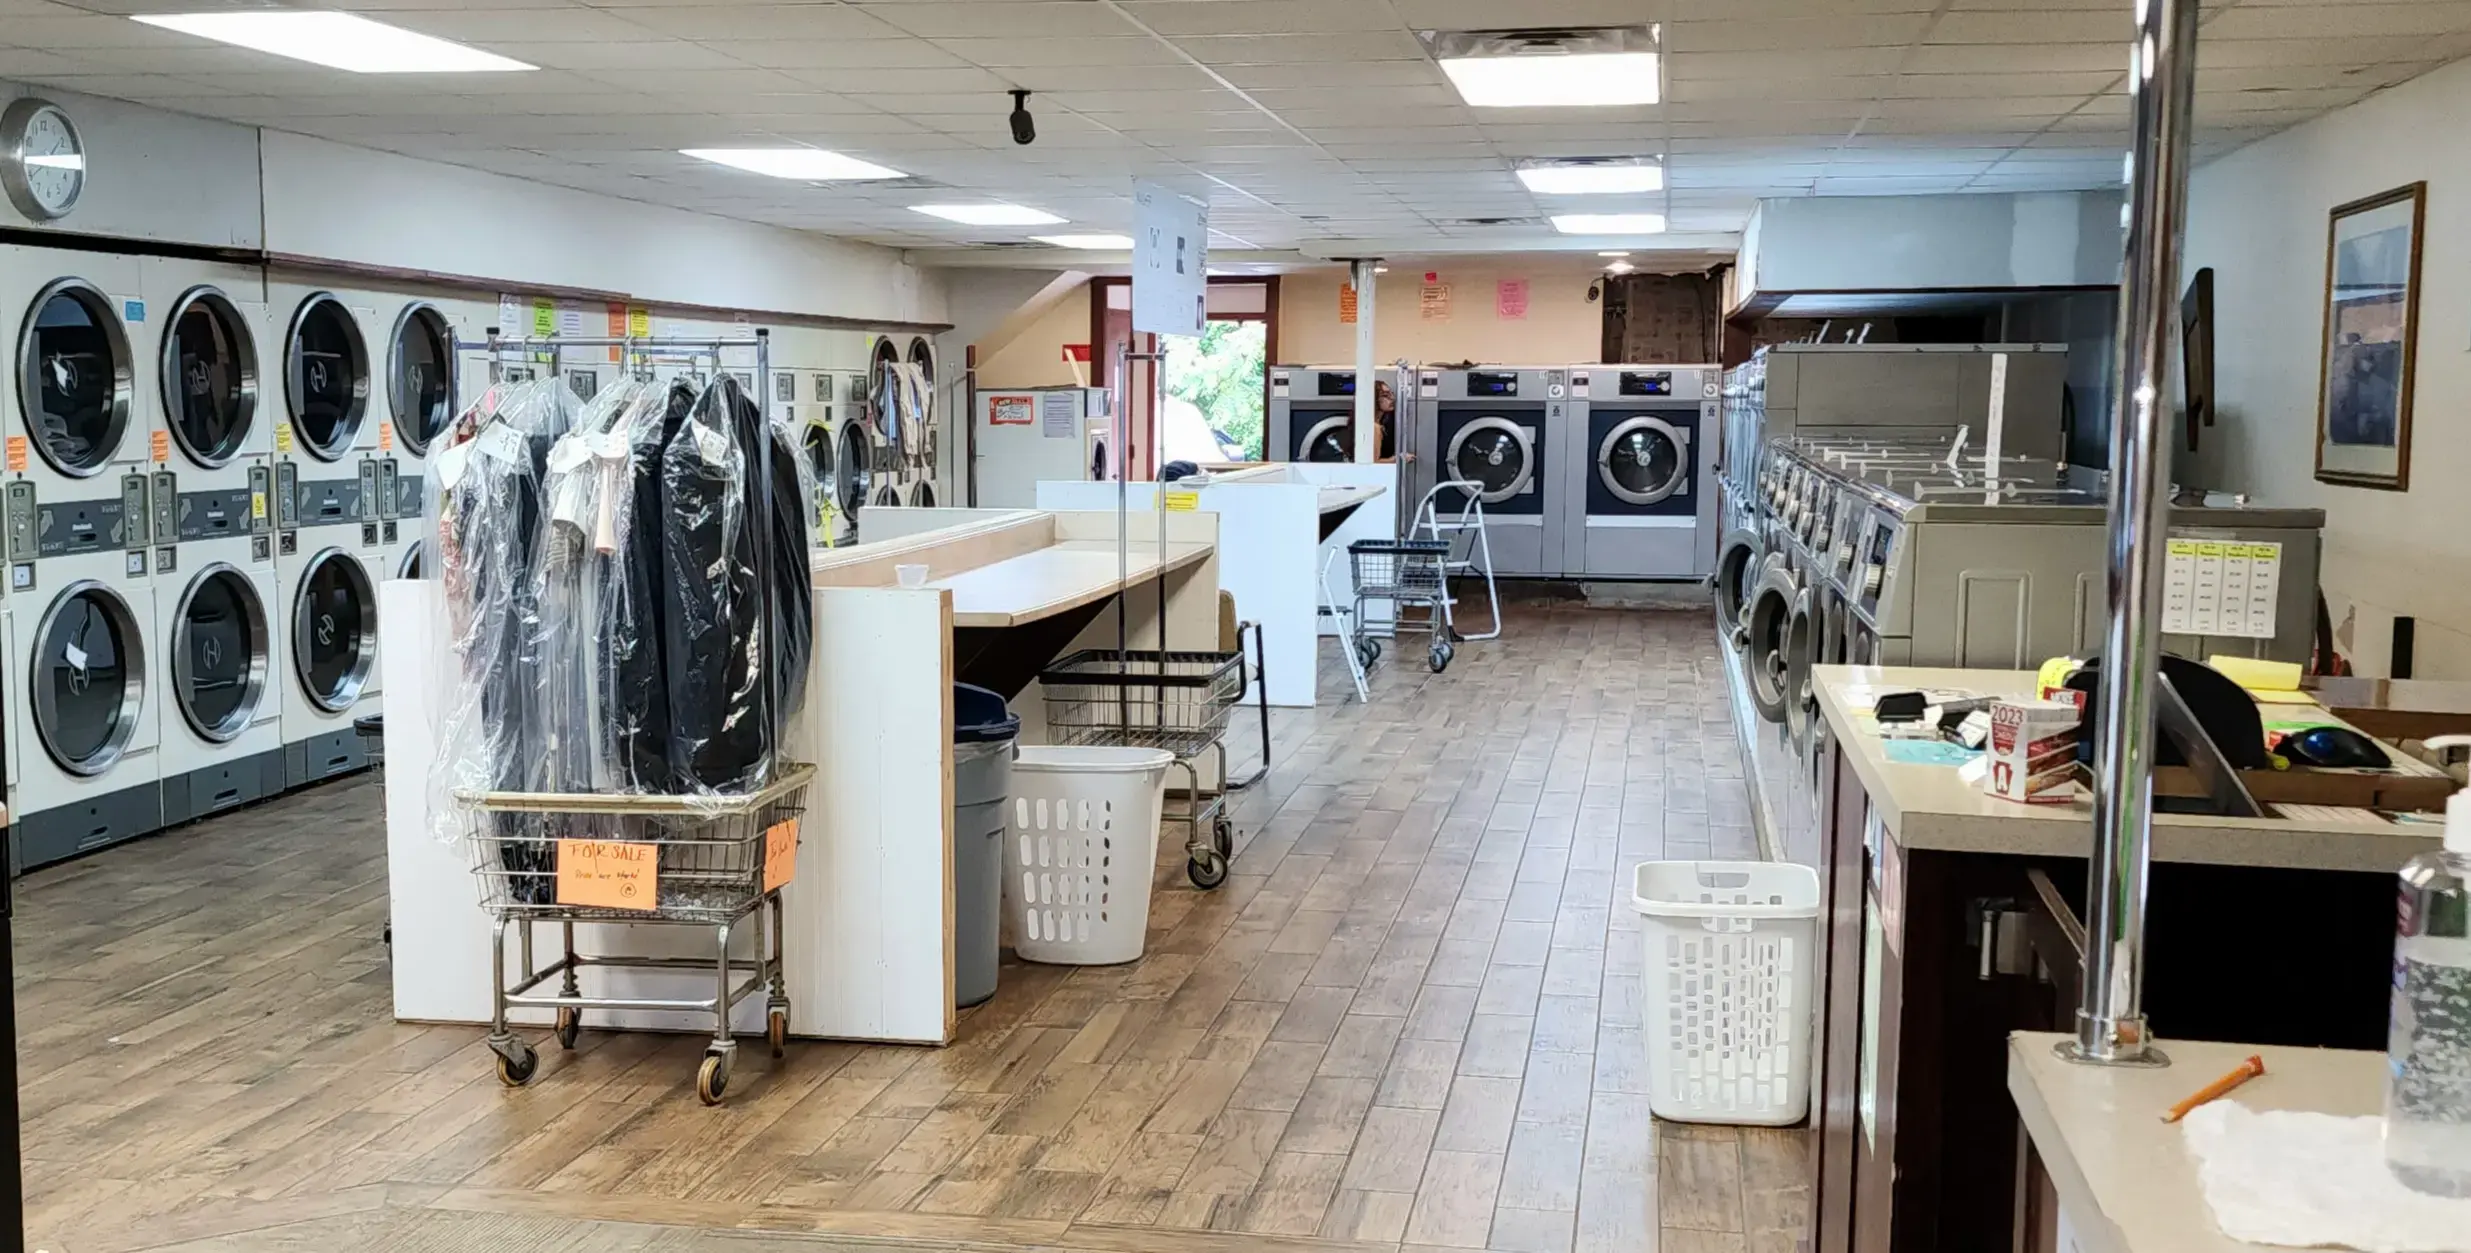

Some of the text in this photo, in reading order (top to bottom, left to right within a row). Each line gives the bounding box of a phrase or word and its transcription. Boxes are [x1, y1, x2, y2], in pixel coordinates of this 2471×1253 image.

[40, 120, 48, 131] 12
[1991, 705, 2024, 725] 2023
[568, 842, 648, 862] FOR SALE
